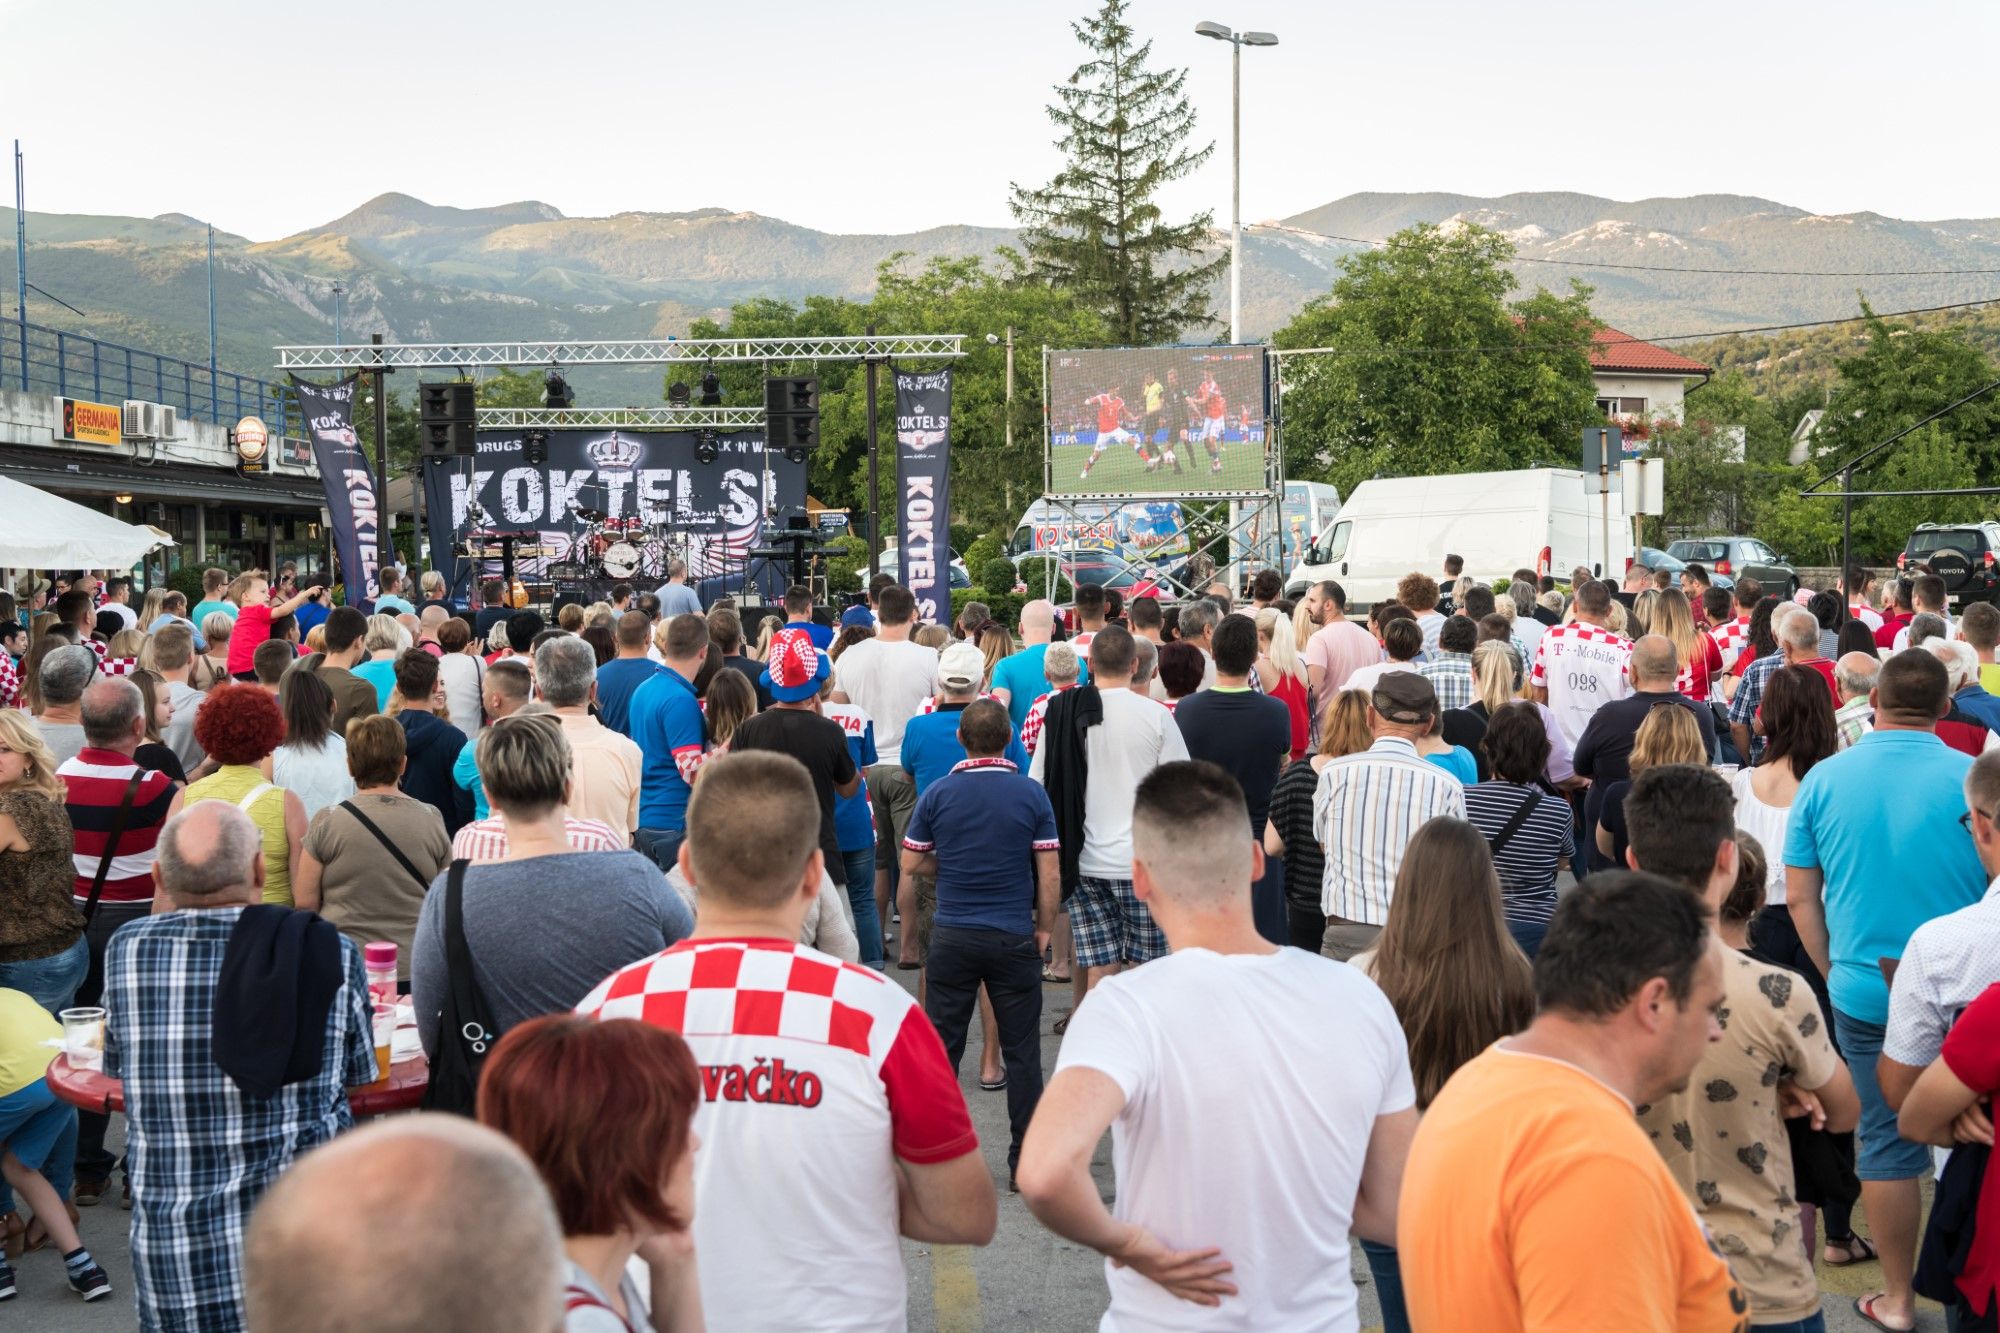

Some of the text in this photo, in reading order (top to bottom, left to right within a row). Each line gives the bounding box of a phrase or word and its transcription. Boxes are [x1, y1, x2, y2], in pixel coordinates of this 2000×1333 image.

[75, 407, 119, 432] GERMANIA
[450, 466, 778, 530] KOKTELSI
[1568, 672, 1597, 693] 098
